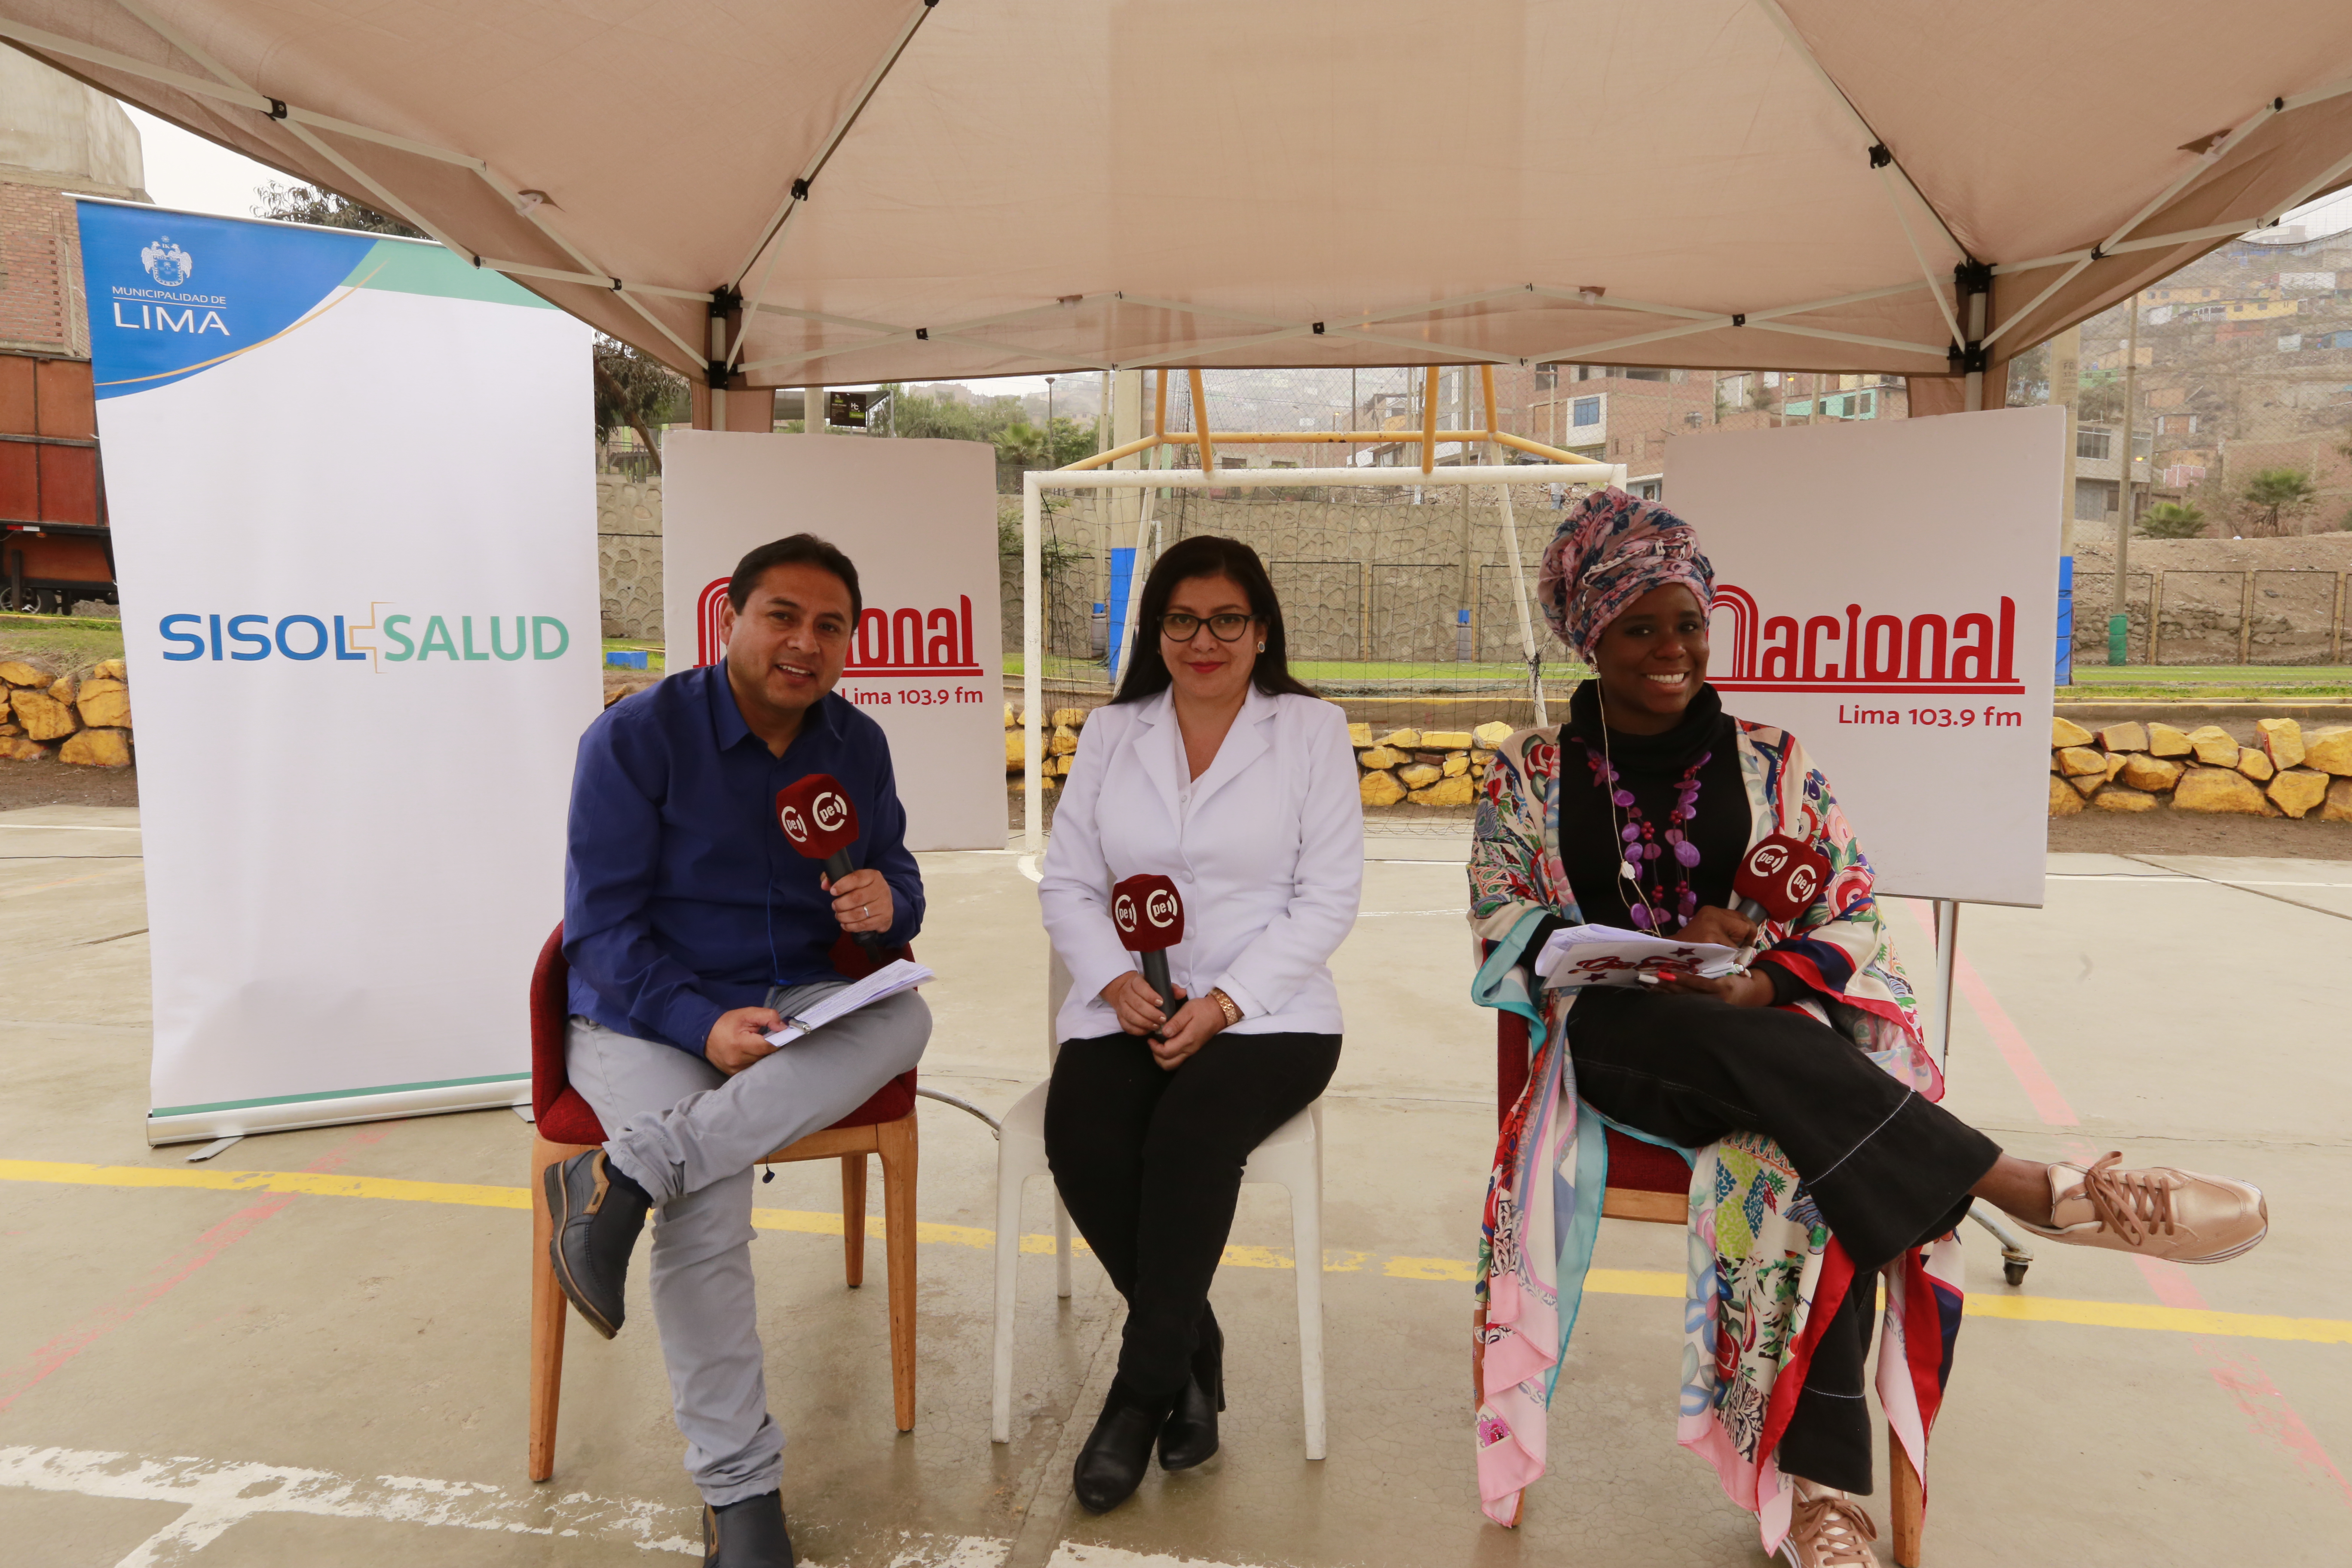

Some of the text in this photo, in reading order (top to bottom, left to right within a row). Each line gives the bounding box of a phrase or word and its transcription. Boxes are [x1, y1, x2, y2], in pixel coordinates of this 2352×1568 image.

[112, 286, 226, 304] MUNICIPALIDAD DE
[113, 302, 230, 336] LIMA
[159, 614, 570, 662] SISOL SALUD
[898, 690, 949, 706] 103.9
[956, 686, 983, 704] fm
[1839, 705, 2022, 728] Lima 103.9 fm
